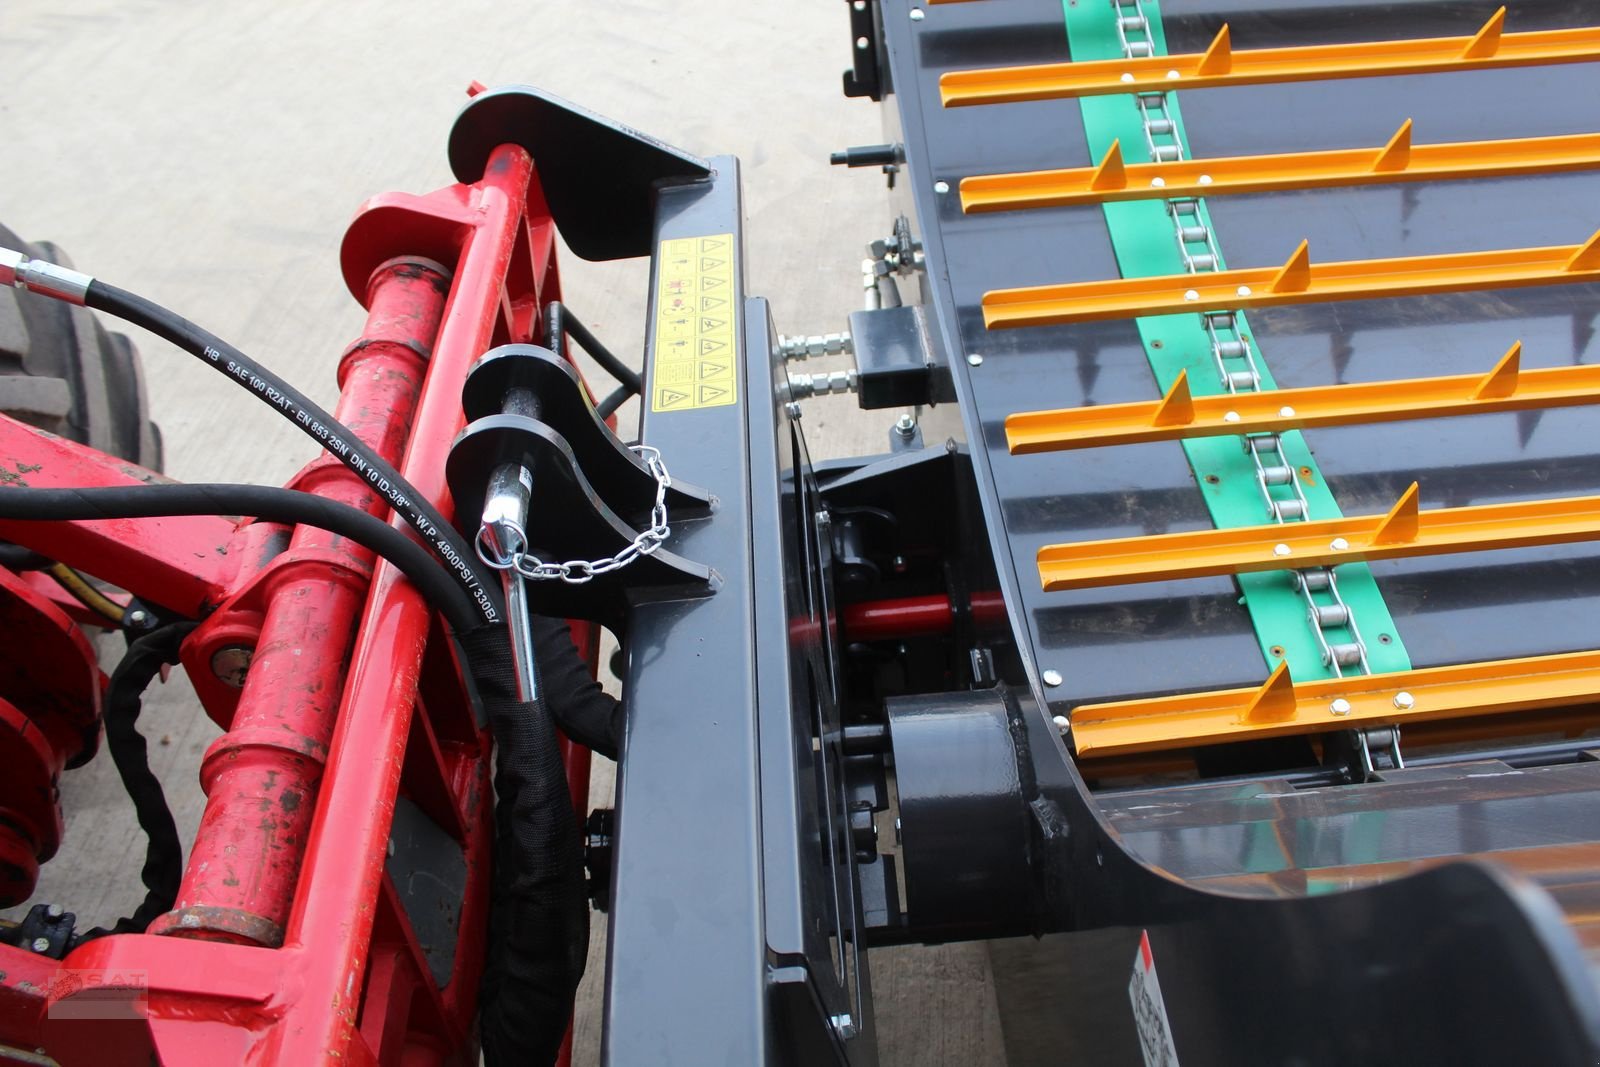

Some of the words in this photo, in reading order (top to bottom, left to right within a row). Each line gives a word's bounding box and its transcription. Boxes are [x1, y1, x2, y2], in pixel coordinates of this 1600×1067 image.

[204, 346, 220, 361] HB
[227, 361, 249, 381] SAE
[249, 376, 266, 392] 100
[265, 387, 292, 410] R2AT
[296, 410, 312, 427] EN
[311, 422, 329, 439] 853
[328, 435, 349, 456] 2SN
[350, 453, 367, 471] DN
[366, 468, 379, 482] 10
[436, 540, 474, 583] 4800PSI
